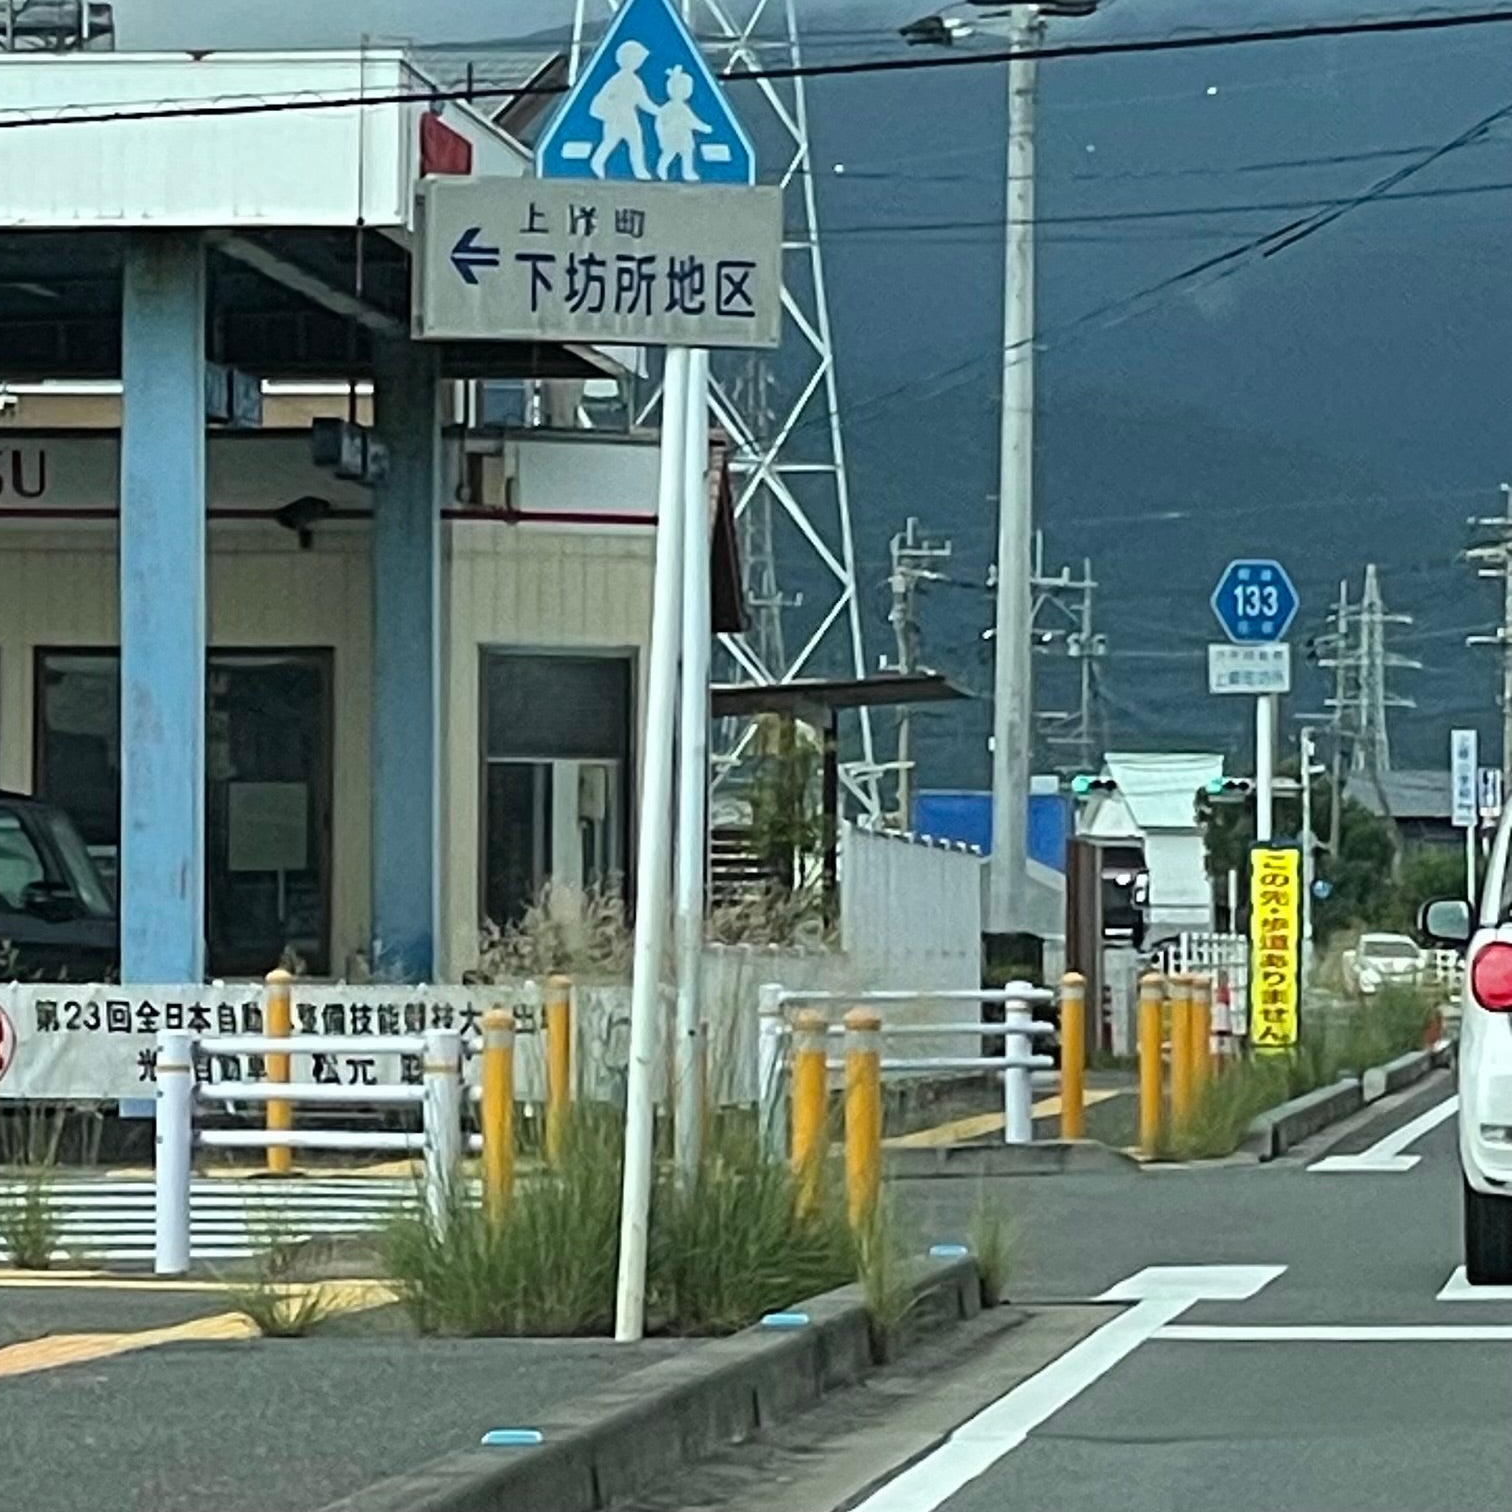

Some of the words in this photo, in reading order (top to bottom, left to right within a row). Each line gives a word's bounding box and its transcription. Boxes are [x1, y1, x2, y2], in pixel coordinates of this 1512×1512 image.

[515, 252, 756, 317] 下坊所地区
[1234, 584, 1278, 617] 133
